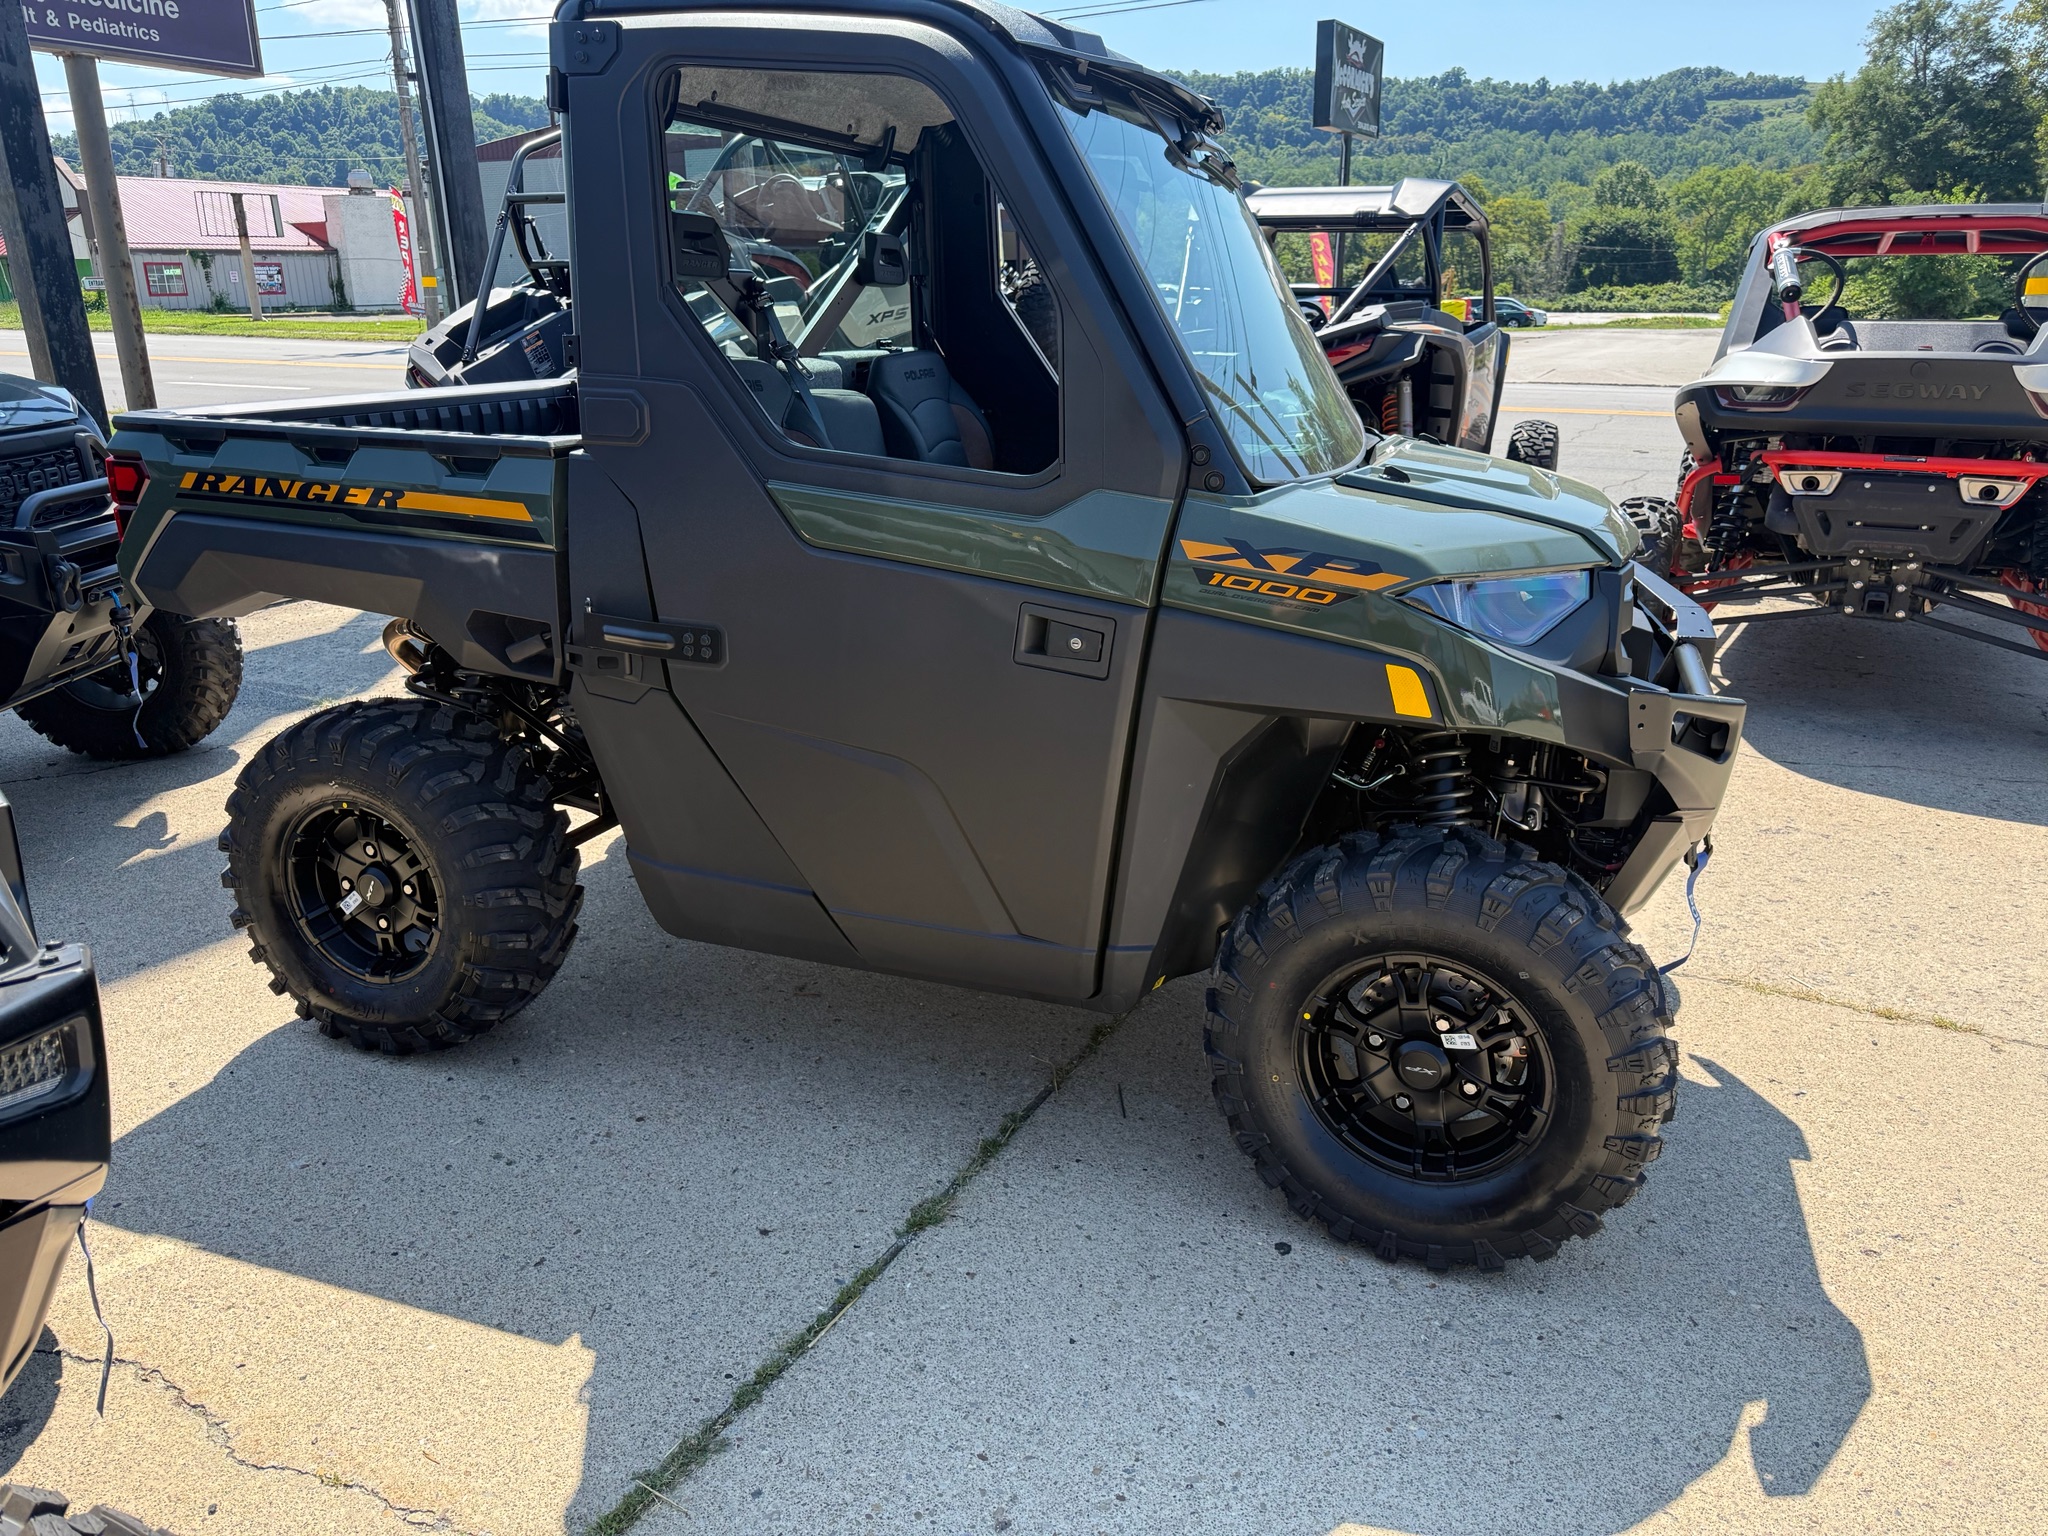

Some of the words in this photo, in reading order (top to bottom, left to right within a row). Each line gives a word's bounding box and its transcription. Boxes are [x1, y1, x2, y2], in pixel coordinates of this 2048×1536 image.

[46, 9, 61, 27] &
[67, 12, 160, 42] Pediatrics
[904, 367, 936, 382] POLARIS
[1845, 382, 1991, 400] SEGWAY
[0, 462, 82, 497] OLARIS
[187, 471, 407, 510] RANGER
[1194, 537, 1384, 577] XP
[1198, 588, 1229, 598] DUAL
[1231, 593, 1293, 609] OVERHEAD
[1294, 604, 1321, 614] CAM
[1208, 572, 1337, 604] 1000
